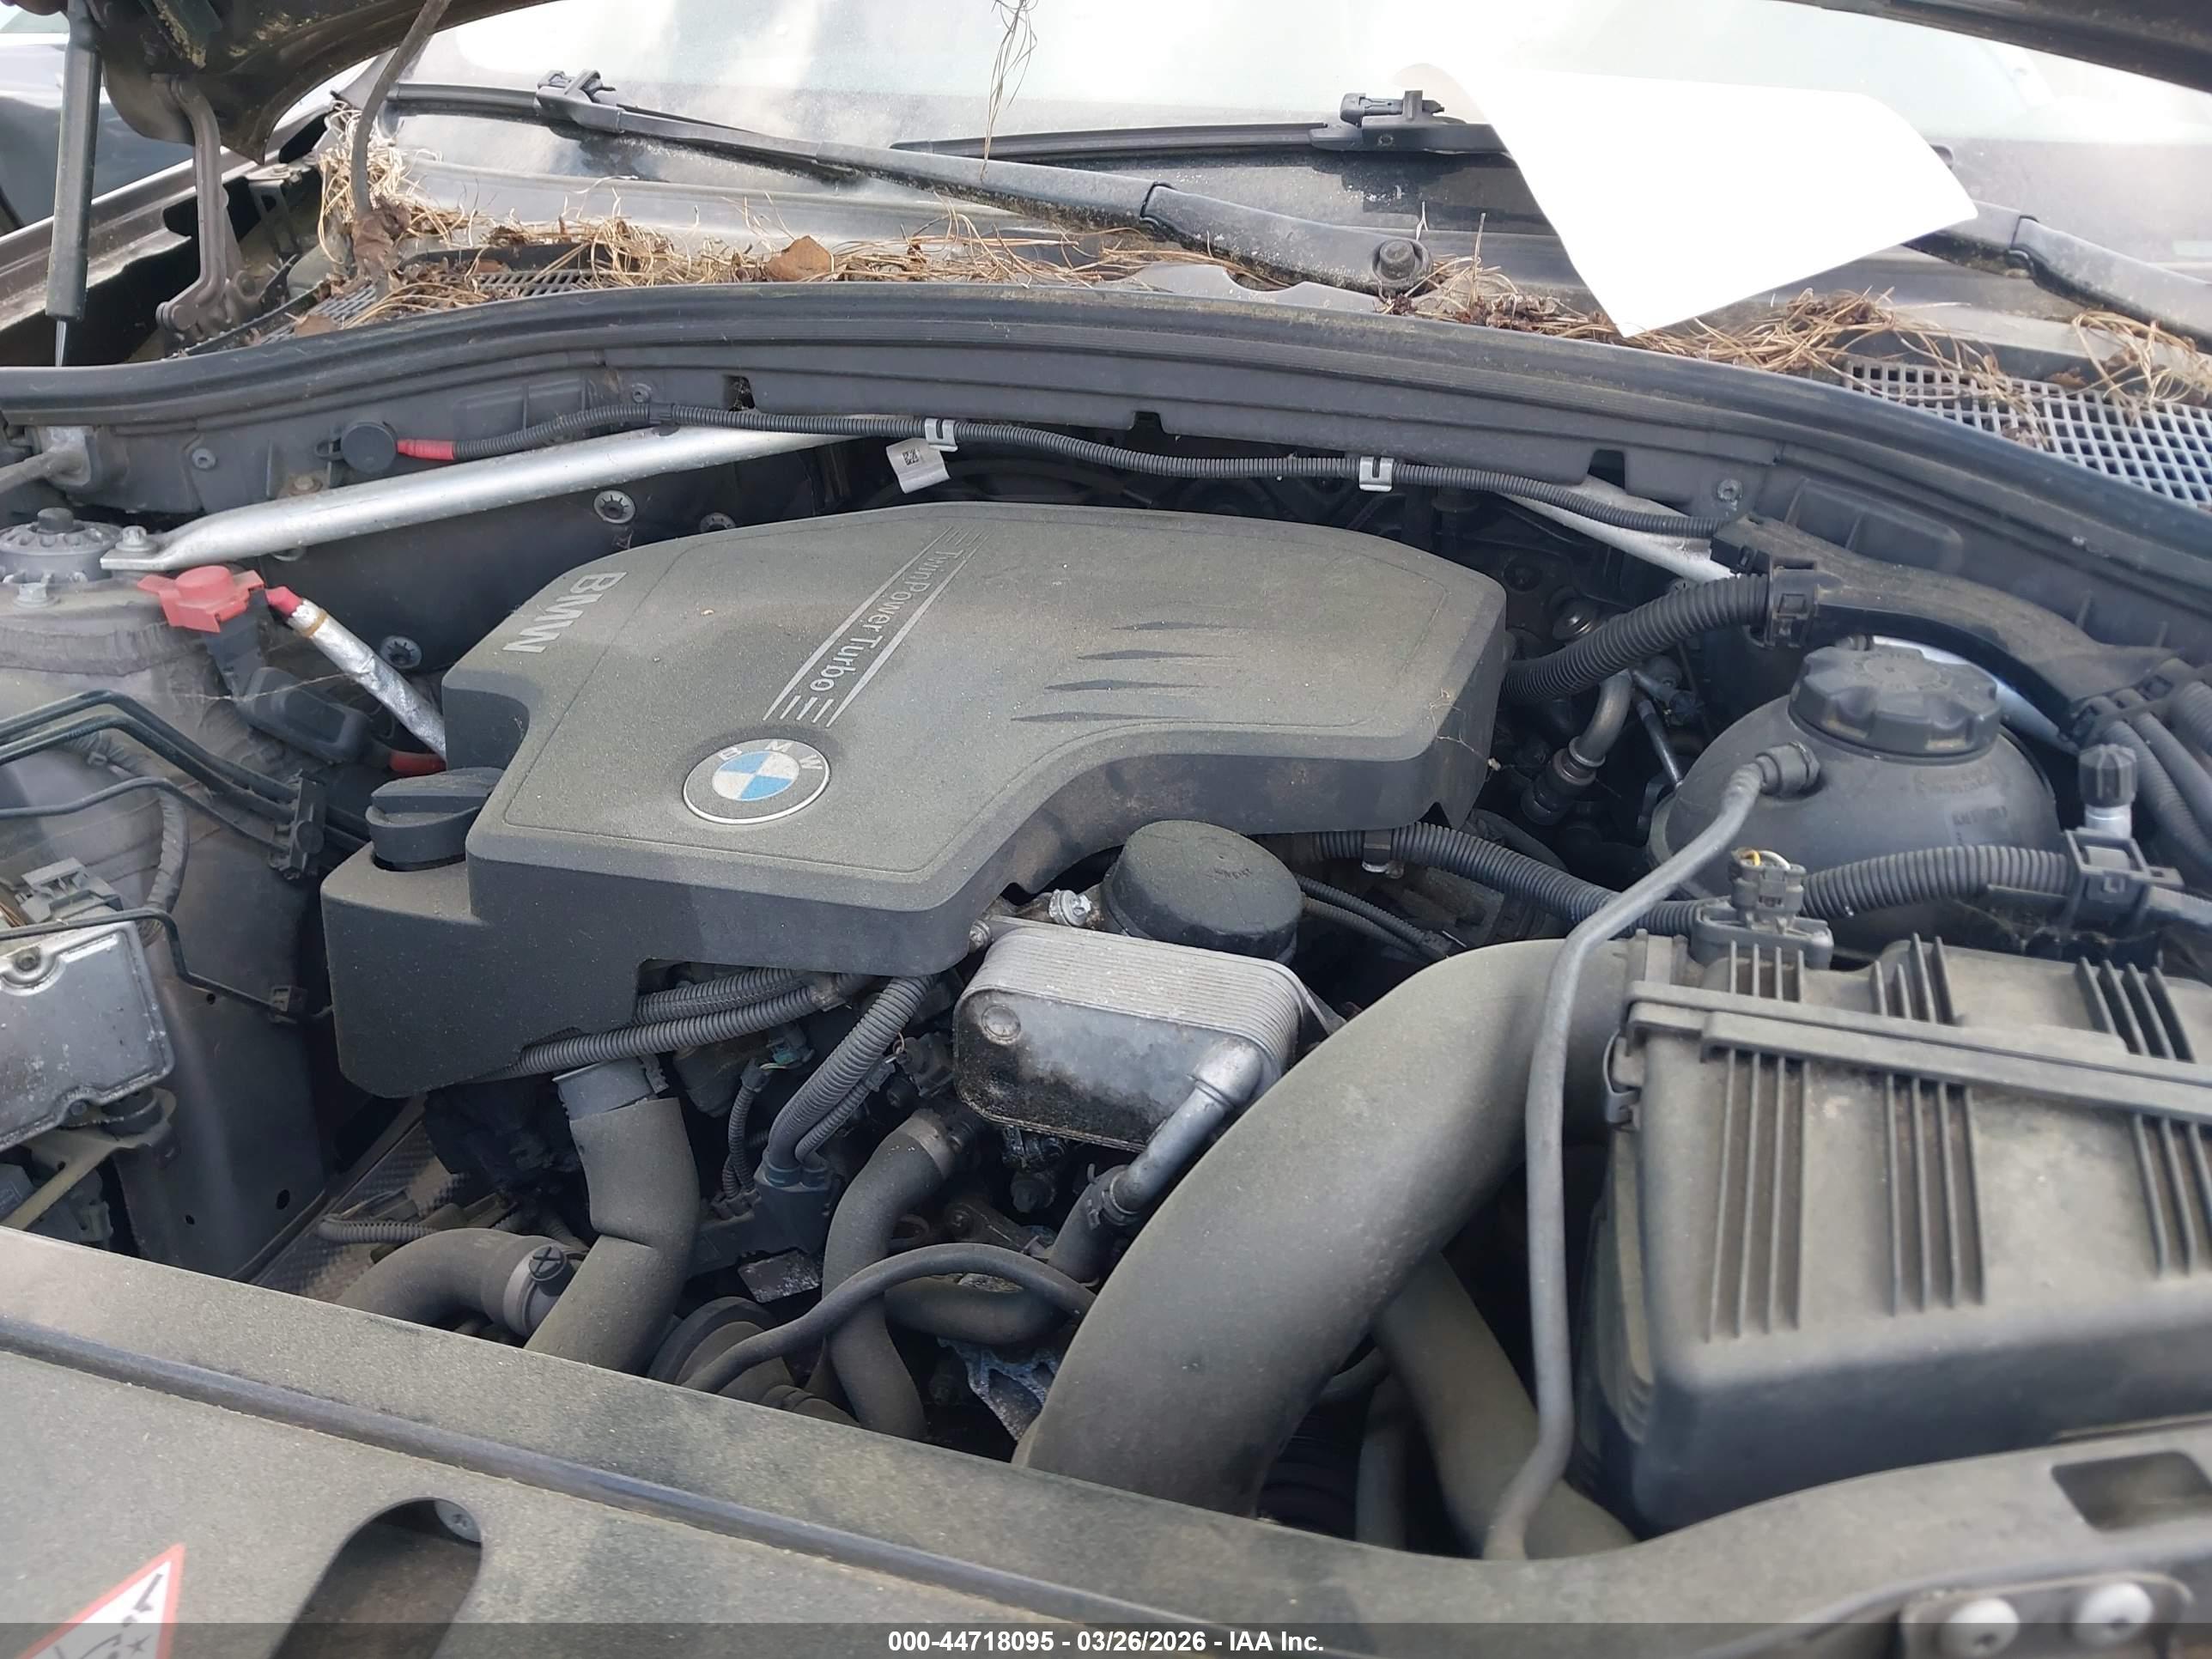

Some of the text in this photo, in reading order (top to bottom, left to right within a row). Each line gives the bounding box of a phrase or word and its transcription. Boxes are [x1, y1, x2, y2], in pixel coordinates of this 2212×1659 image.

[501, 570, 629, 654] BMW
[810, 549, 964, 692] TwinPower Turbo
[716, 740, 824, 771] BMW
